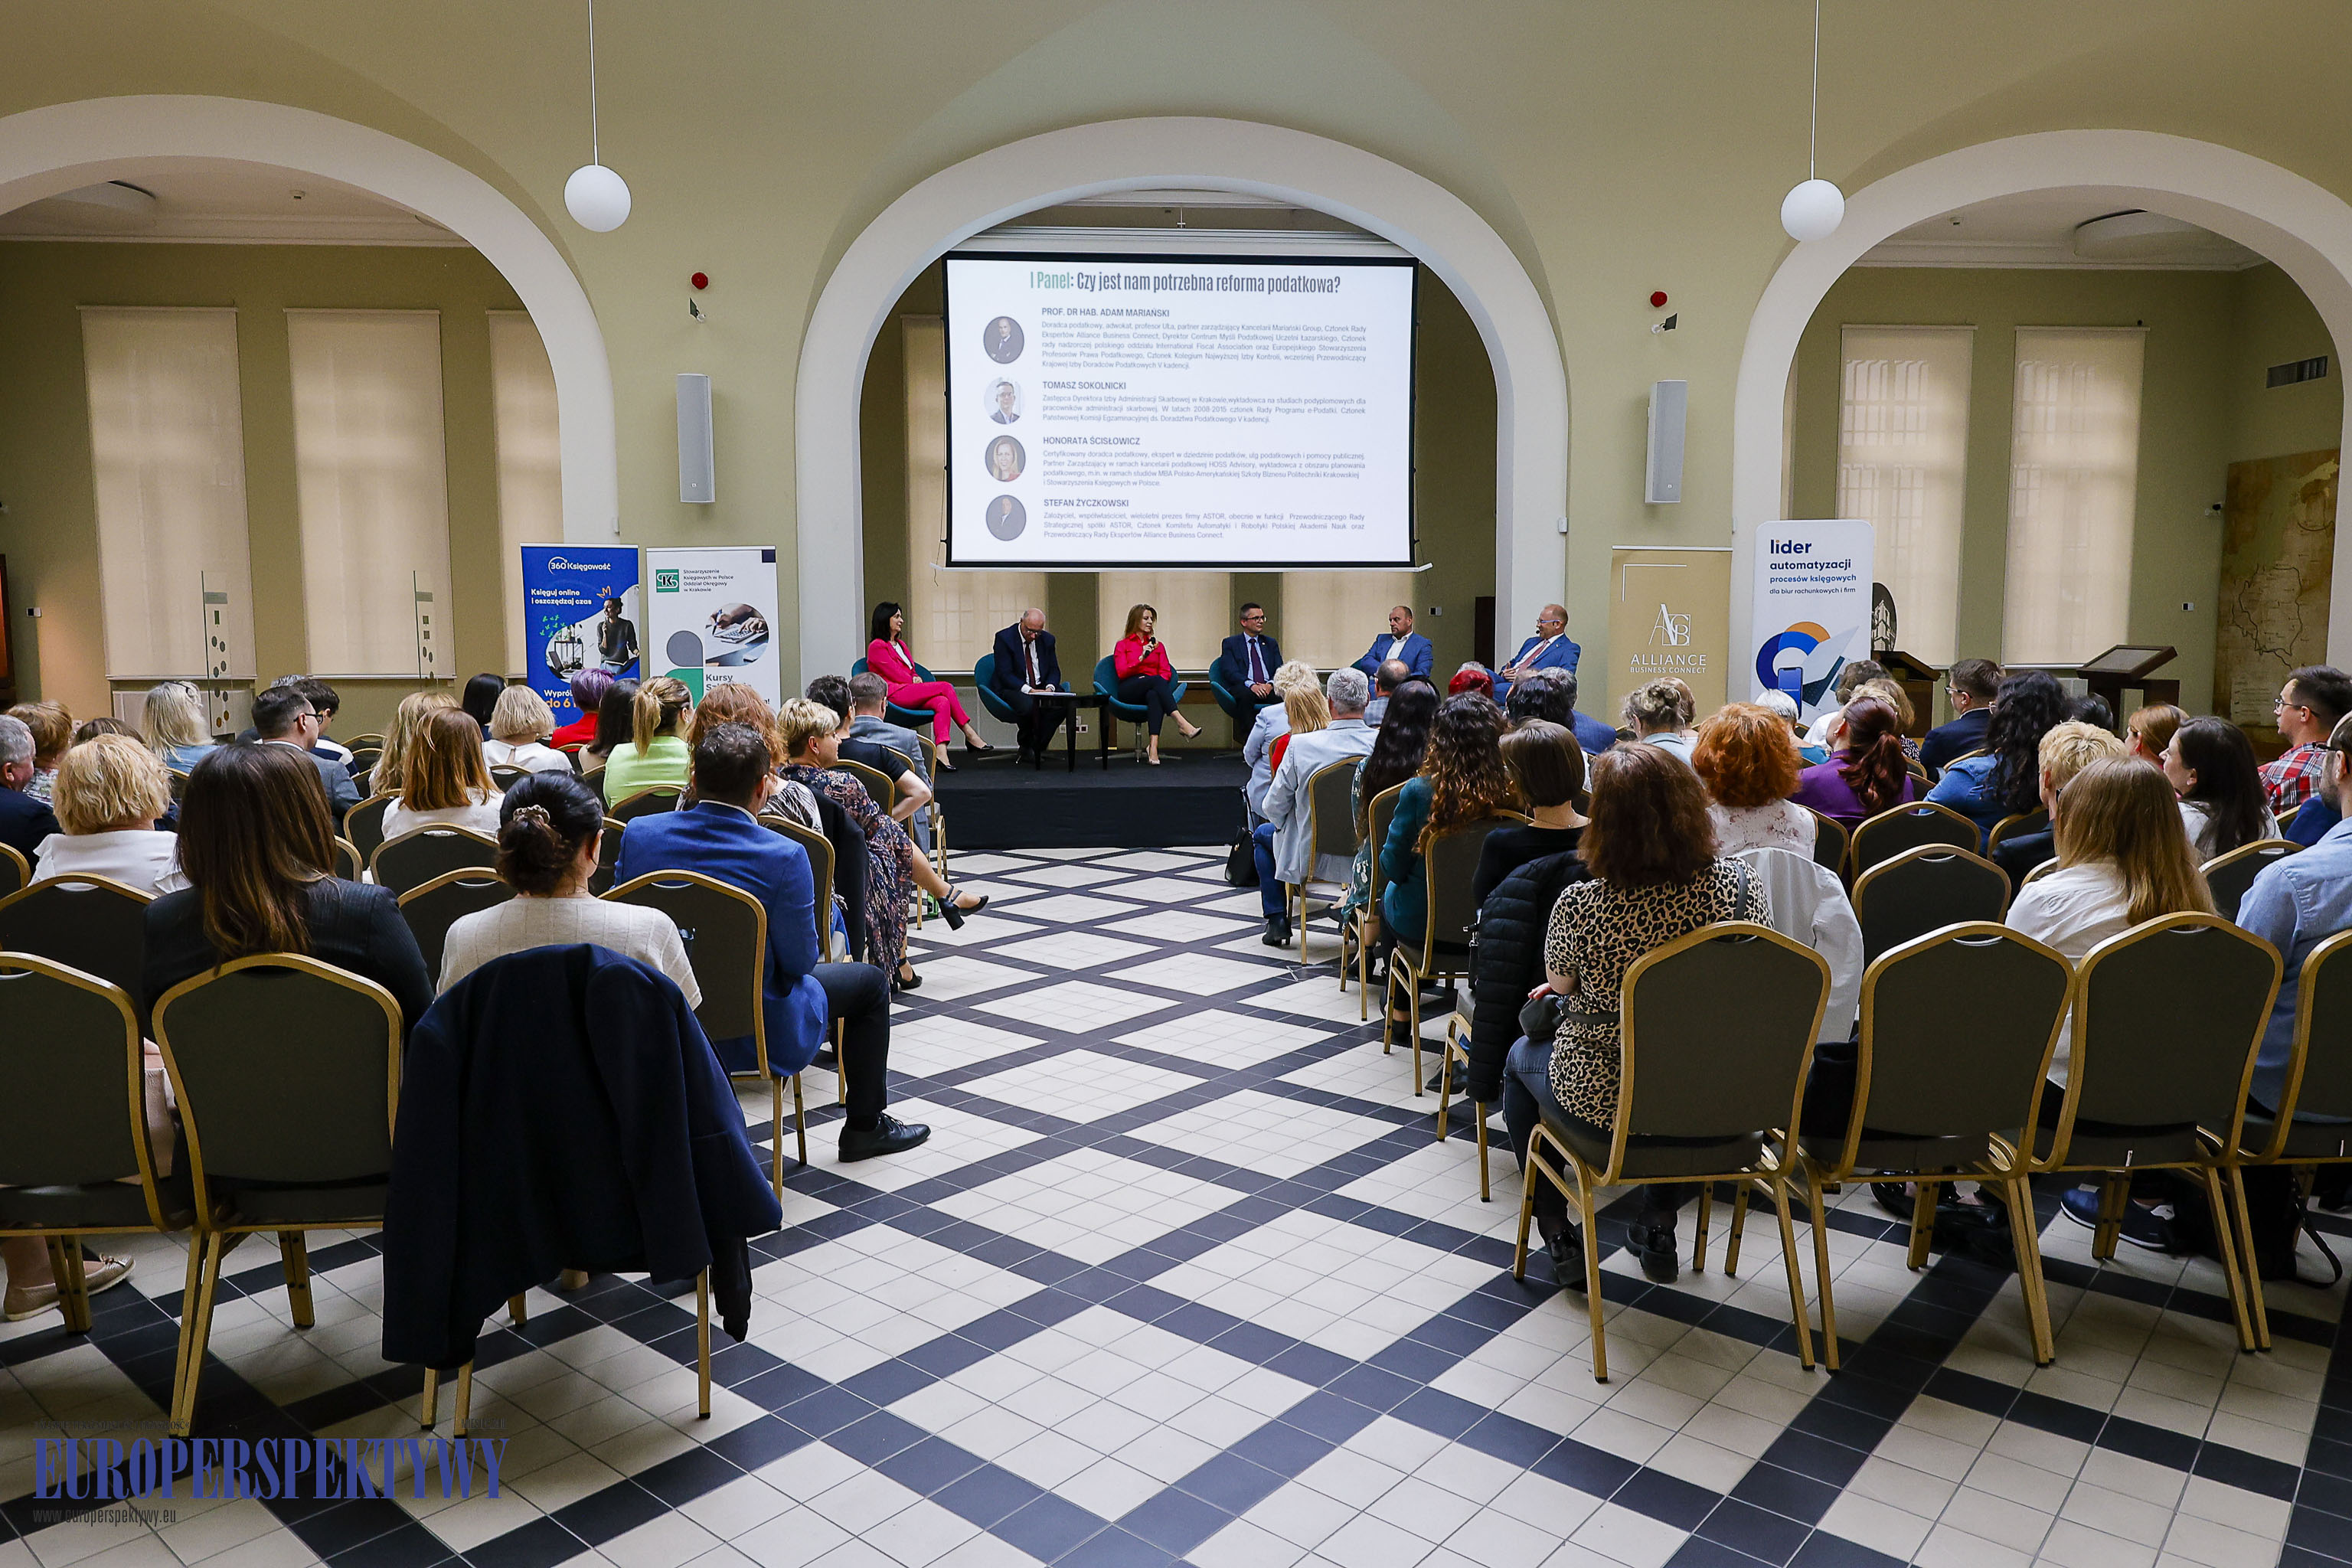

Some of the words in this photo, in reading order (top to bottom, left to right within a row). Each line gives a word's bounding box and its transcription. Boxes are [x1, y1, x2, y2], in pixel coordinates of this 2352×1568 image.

[1030, 272, 1034, 289] I
[1037, 272, 1074, 289] Panel:
[1076, 273, 1096, 291] Czy
[1098, 273, 1122, 292] jest
[1123, 276, 1150, 290] nam
[1153, 273, 1214, 292] potrzebna
[1216, 275, 1265, 292] reforma
[1267, 276, 1341, 295] podatkowa?
[1066, 308, 1078, 316] DR
[1079, 308, 1098, 316] HAB.
[1125, 308, 1170, 317] MARIAŃSKI
[1077, 381, 1126, 390] SOKOLNICKI
[1043, 436, 1088, 445] HONORATA
[1089, 436, 1141, 445] ŚCISŁOWICZ
[1043, 498, 1074, 507] STEFAN
[1075, 498, 1129, 507] ŻYCZKOWSKI
[1770, 539, 1811, 554] lider
[1769, 559, 1851, 571] automatyzacji
[1811, 574, 1856, 583] księgowych
[1631, 654, 1707, 665] ALLIANCE
[706, 674, 733, 682] Kursy
[546, 698, 560, 708] do
[564, 698, 570, 708] 6
